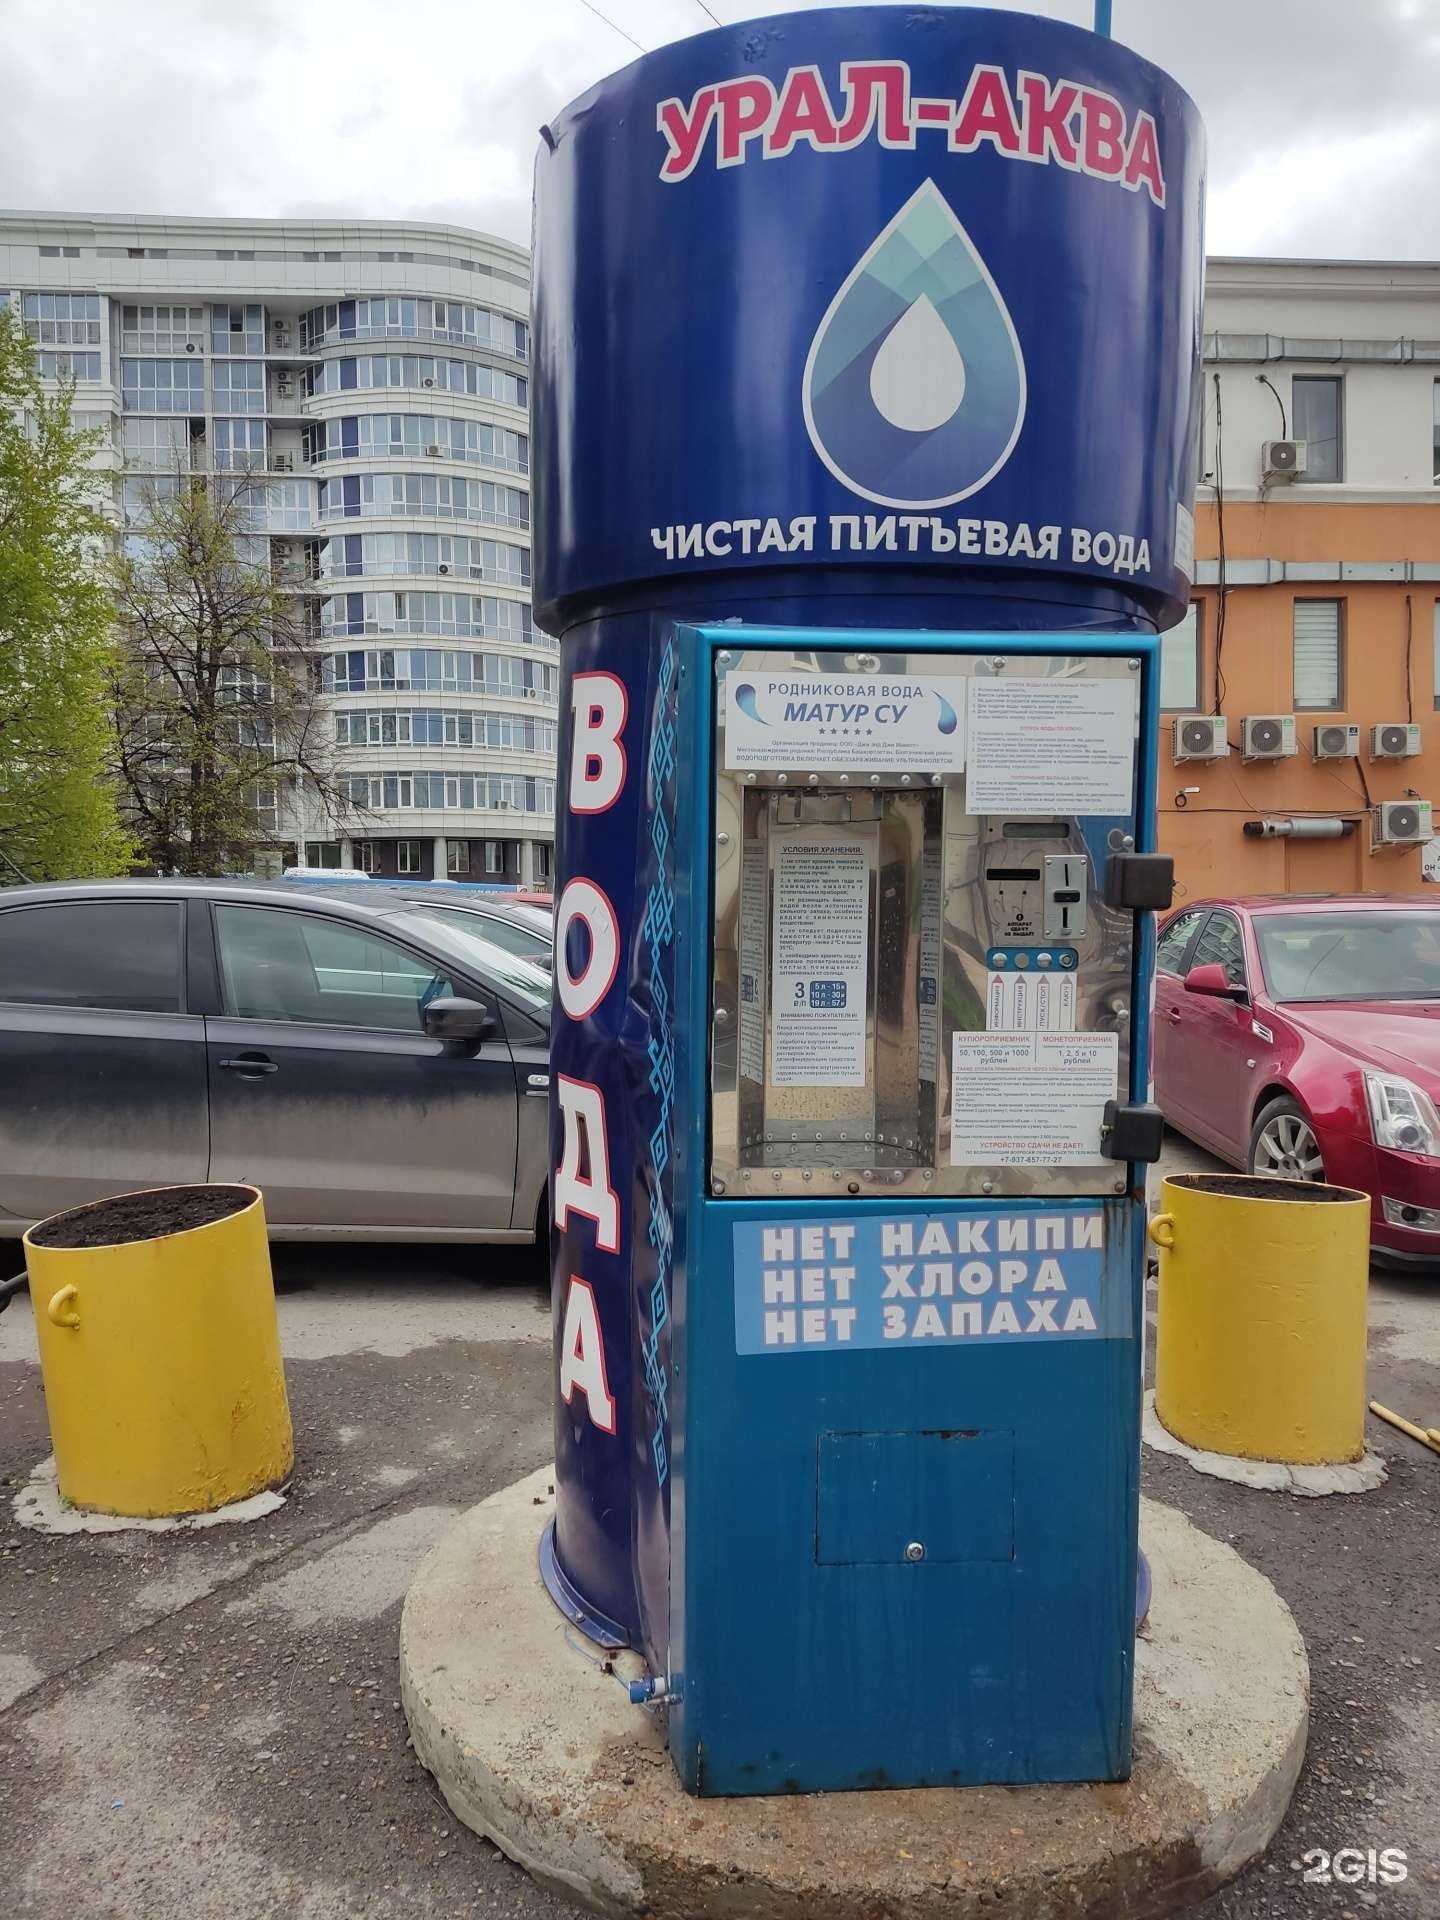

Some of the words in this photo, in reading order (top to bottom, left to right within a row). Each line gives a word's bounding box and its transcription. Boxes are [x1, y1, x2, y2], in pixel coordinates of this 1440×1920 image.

[657, 60, 1166, 210] УРАЛ-АКВА
[651, 515, 816, 560] ЧИСТАЯ
[829, 515, 1061, 560] ПИТЬЕВАЯ
[1071, 528, 1151, 576] ВОДА
[768, 683, 876, 697] РОДНИКОВАЯ
[882, 686, 924, 698] ВОДА
[784, 702, 869, 723] МАТУР
[875, 704, 908, 723] СУ
[782, 846, 819, 854] УСЛОВИЯ
[820, 846, 864, 854] ХРАНЕНИЯ:
[795, 982, 805, 998] 3
[555, 671, 628, 1435] ВОДА
[763, 1226, 856, 1262] НЕТ
[881, 1216, 1103, 1257] НАКИПИ
[763, 1267, 856, 1303] НЕТ
[881, 1259, 1067, 1299] ХЛОРА
[764, 1308, 857, 1345] НЕТ
[882, 1298, 1097, 1339] ЗАПАХА
